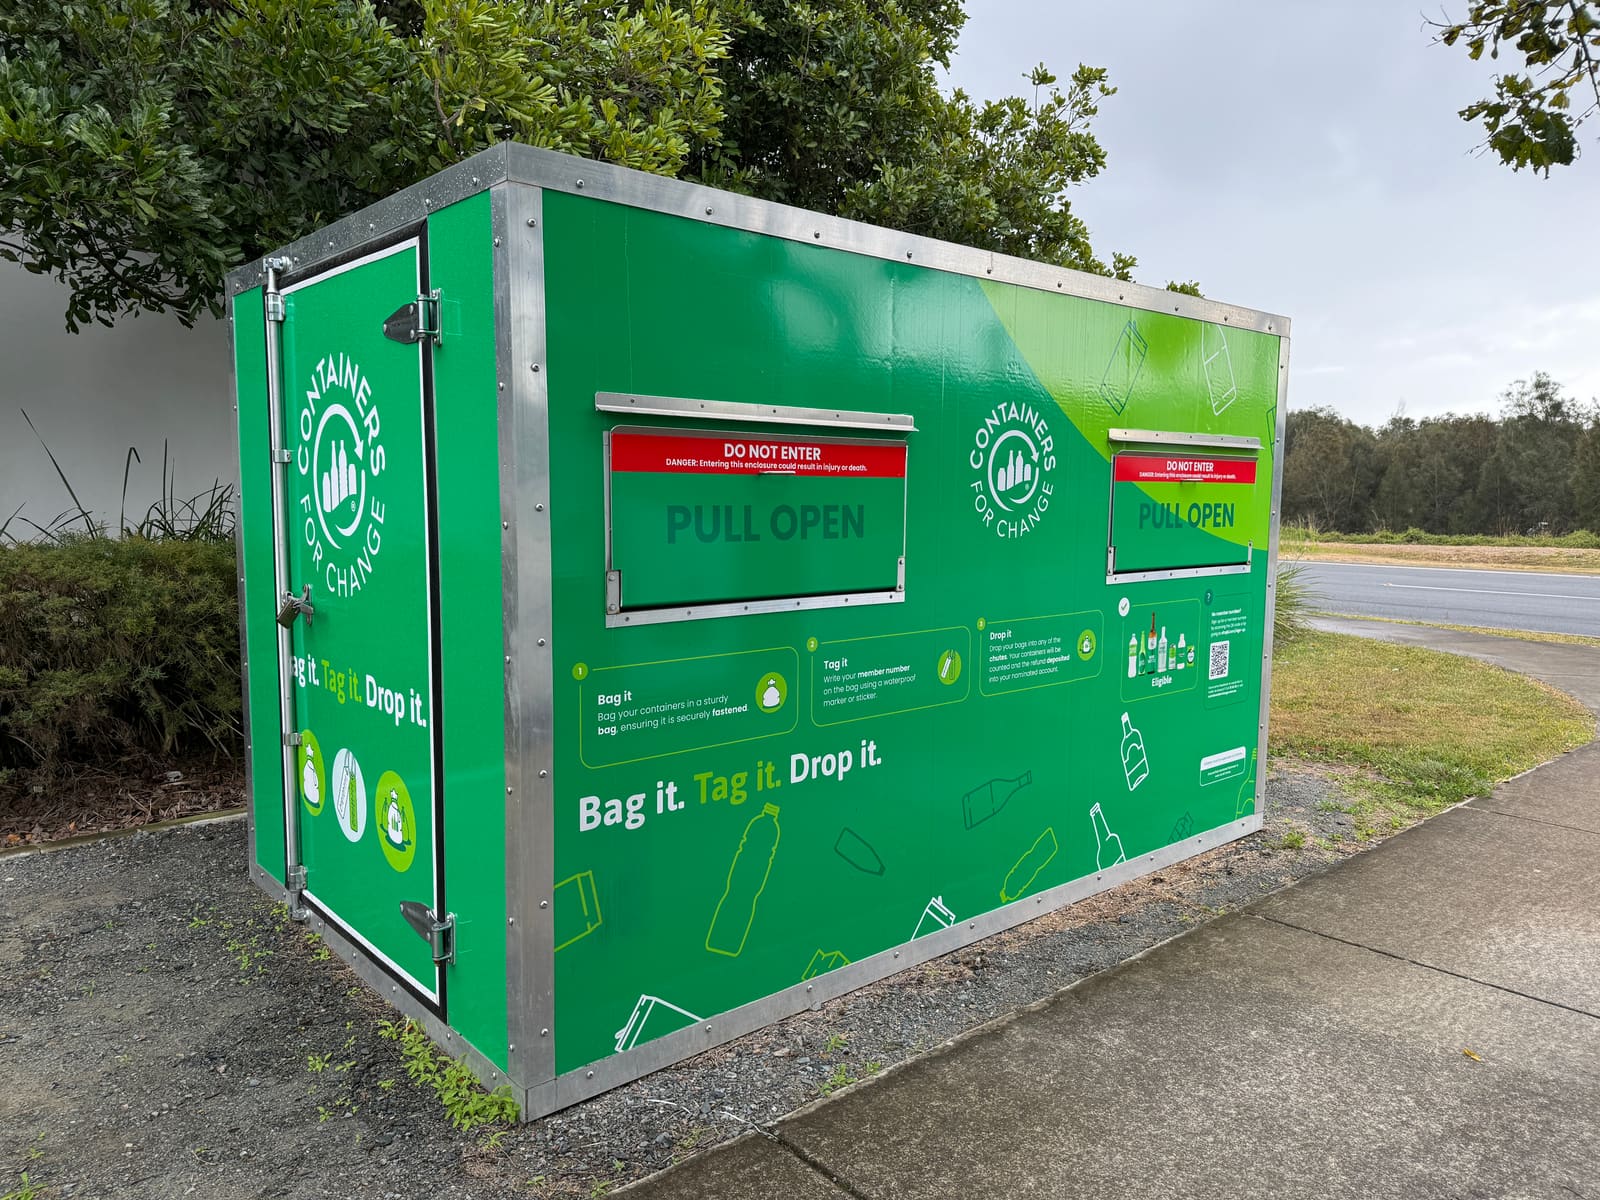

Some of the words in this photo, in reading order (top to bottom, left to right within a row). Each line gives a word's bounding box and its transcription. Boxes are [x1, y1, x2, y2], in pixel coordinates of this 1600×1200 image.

[298, 352, 386, 476] CONTAINERS
[970, 401, 1056, 472] CONTAINERS
[724, 443, 746, 458] DO
[749, 444, 778, 459] NOT
[781, 446, 821, 460] ENTER
[665, 458, 698, 467] DANGER:
[699, 459, 729, 469] Entering
[730, 460, 743, 468] this
[744, 461, 777, 469] enclosure
[823, 462, 840, 472] injury
[848, 463, 867, 471] death.
[1166, 461, 1177, 471] DO
[1178, 461, 1193, 471] NOT
[1193, 462, 1214, 472] ENTER
[970, 480, 994, 528] FOR
[997, 481, 1054, 538] CHANGE
[1139, 503, 1184, 529] PULL
[1187, 502, 1235, 528] OPEN
[666, 504, 760, 544] PULL
[769, 504, 864, 541] OPEN
[300, 494, 323, 571] FOR
[326, 496, 385, 598] CHANGE
[990, 631, 1006, 641] Drop
[1006, 629, 1012, 638] it
[989, 643, 1002, 653] Drop
[1003, 643, 1014, 651] your
[1014, 641, 1027, 650] bags
[1020, 648, 1046, 657] containers
[823, 660, 840, 671] Tag
[842, 657, 848, 667] it
[989, 663, 1011, 673] counted
[1021, 660, 1030, 668] the
[1046, 653, 1070, 664] deposited
[823, 674, 841, 683] Write
[842, 672, 857, 682] your
[857, 668, 885, 678] member
[885, 665, 910, 674] number
[833, 685, 845, 694] the
[845, 683, 859, 693] bag
[860, 680, 877, 690] using
[883, 673, 916, 686] waterproof
[999, 673, 1011, 682] your
[1011, 668, 1038, 679] nominated
[1151, 675, 1172, 688] Eligible
[308, 654, 319, 686] it.
[321, 659, 346, 704] Tag
[348, 667, 362, 703] it.
[365, 674, 405, 726] Drop
[410, 688, 427, 728] it.
[597, 693, 622, 706] Bag
[624, 690, 632, 702] it
[823, 695, 847, 706] marker
[847, 695, 855, 703] or
[597, 712, 616, 722] Bag
[617, 708, 638, 720] your
[640, 701, 686, 715] containers
[687, 699, 694, 707] in
[703, 694, 729, 704] sturdy
[597, 725, 618, 735] bag,
[620, 718, 659, 732] ensuring
[660, 715, 667, 725] it
[668, 714, 675, 724] is
[676, 710, 710, 723] securely
[579, 793, 646, 832] Bag
[656, 780, 685, 814] it.
[693, 771, 748, 806] Tag
[756, 760, 782, 792] it.
[790, 748, 853, 784] Drop
[860, 739, 882, 768] it.
